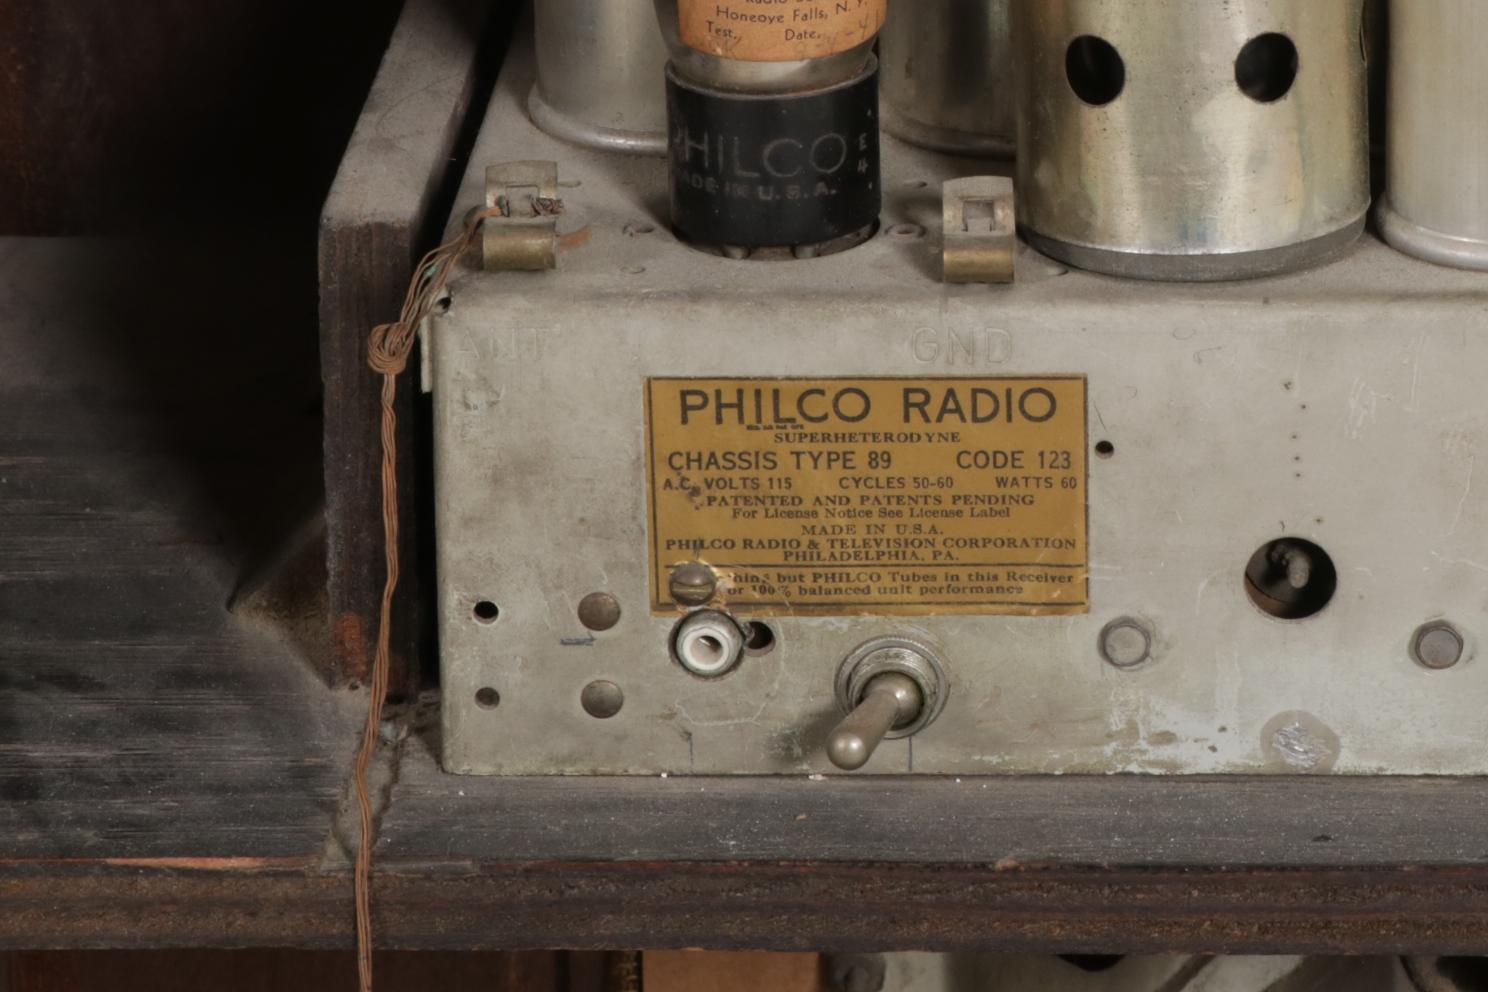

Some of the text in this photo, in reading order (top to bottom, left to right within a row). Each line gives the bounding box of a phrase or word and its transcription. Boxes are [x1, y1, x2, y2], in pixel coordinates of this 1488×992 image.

[716, 6, 785, 25] Honeoye
[792, 6, 829, 23] Falls,
[836, 1, 851, 15] N.
[785, 28, 822, 42] Date.
[672, 124, 848, 178] PHILCO
[911, 326, 1012, 366] GND
[680, 387, 1057, 425] PHILCO RADIO
[774, 432, 961, 444] SUPERHETERODYNE
[668, 450, 1072, 471] CHASSIS TYPE 89 CODE 123
[663, 476, 1077, 491] A.C. VOLTS 115 CYCLES 50-60 WATTS 60
[706, 494, 1035, 507] PATENTED AND PATENTS PENDING
[732, 507, 1010, 519] For License Notice See License Label
[801, 524, 944, 535] MADE IN U.S.A.
[665, 538, 1076, 550] PHILCO RADIO & TELEVISION CORPORATION
[932, 550, 959, 561] PA.
[777, 573, 805, 584] but
[812, 573, 881, 584] PHILCO
[888, 572, 937, 583] Tubes
[945, 572, 960, 583] in
[968, 572, 998, 583] this
[1007, 572, 1073, 584] Receiver
[798, 585, 871, 596] balanced
[878, 585, 912, 595] unit
[920, 584, 1023, 596] performance
